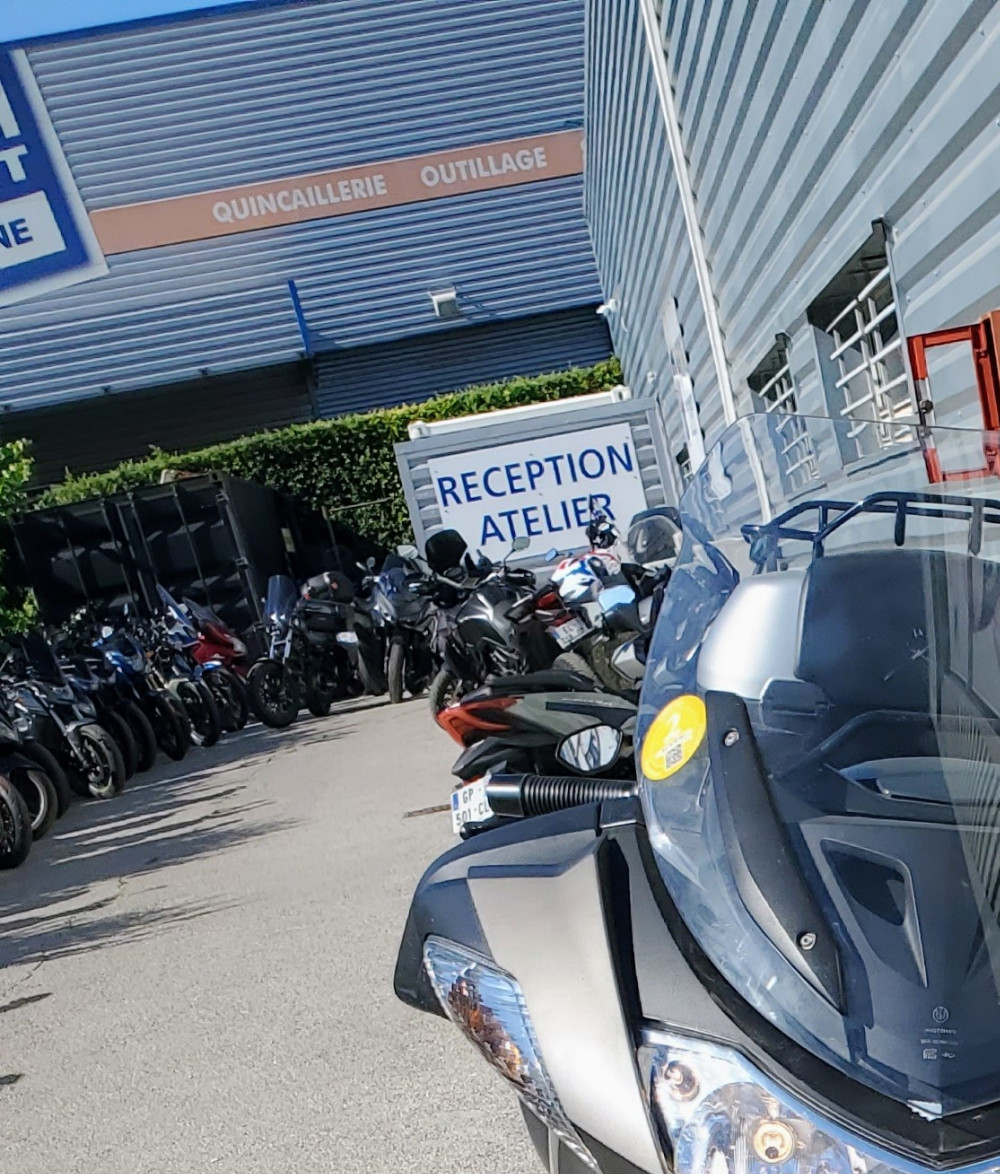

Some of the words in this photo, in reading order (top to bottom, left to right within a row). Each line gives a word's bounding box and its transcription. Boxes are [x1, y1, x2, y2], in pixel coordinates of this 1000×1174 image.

[212, 174, 388, 224] QUINCAILLERIE
[420, 147, 548, 188] OUTILLAGE
[437, 442, 633, 508] RECEPTION
[480, 493, 616, 546] ATELIER
